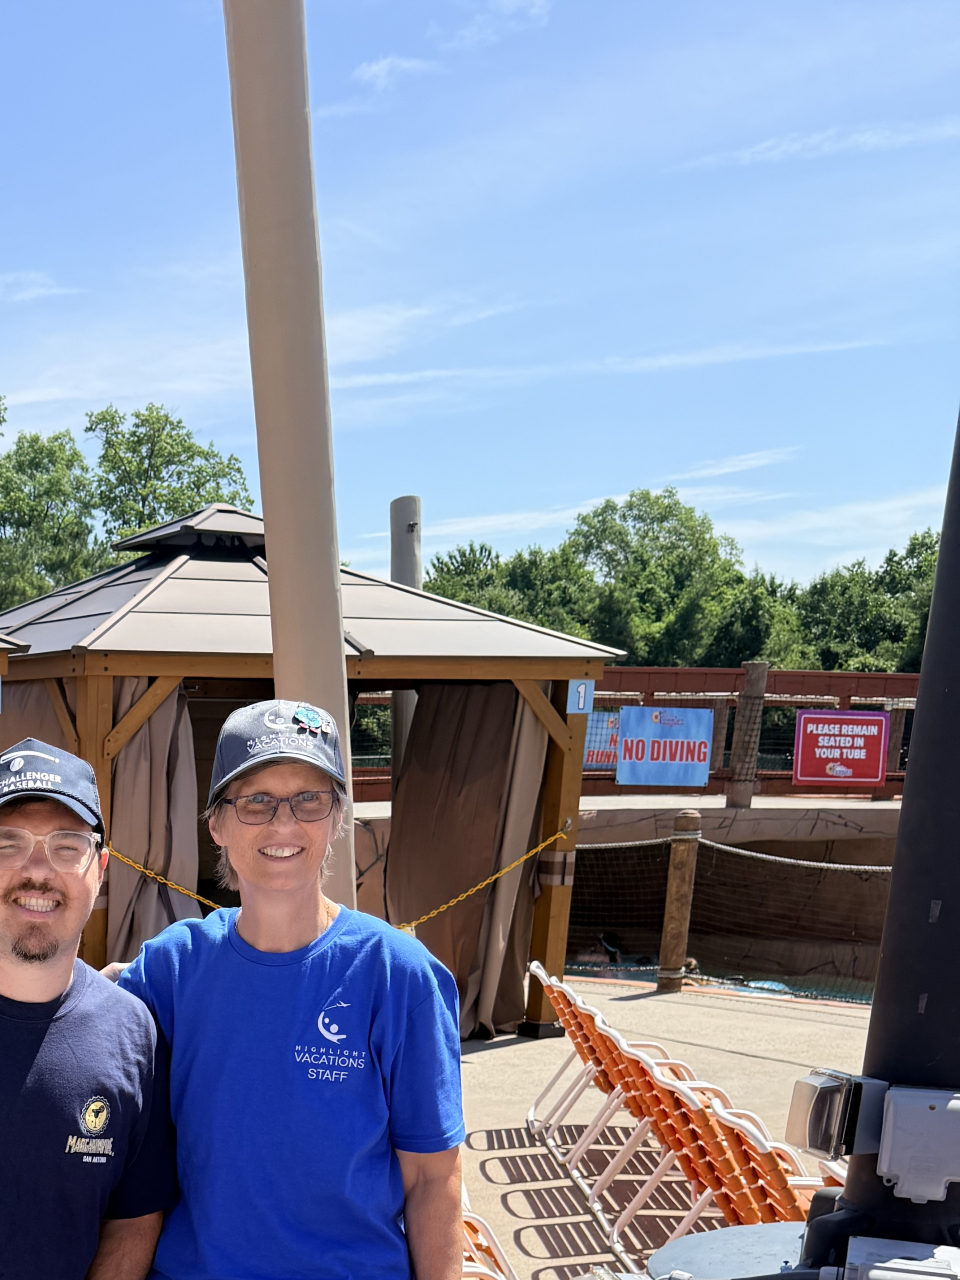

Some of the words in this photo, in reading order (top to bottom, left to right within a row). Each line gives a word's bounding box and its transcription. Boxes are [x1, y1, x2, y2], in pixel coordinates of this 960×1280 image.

[577, 683, 586, 710] 1
[807, 723, 840, 735] PLEASE
[841, 725, 878, 736] REMAIN
[247, 732, 313, 747] HIGHLIGHT
[247, 736, 314, 753] VACATIONS
[818, 736, 852, 747] SEATED
[854, 737, 864, 748] IN
[622, 738, 646, 762] NO
[649, 739, 708, 763] DIVING
[815, 748, 840, 759] YOUR
[842, 749, 866, 760] TUBE
[3, 780, 53, 794] BASEBALL
[295, 1045, 367, 1058] HIGHLIGHT
[294, 1051, 366, 1069] VACATIONS
[308, 1068, 349, 1082] STAFF
